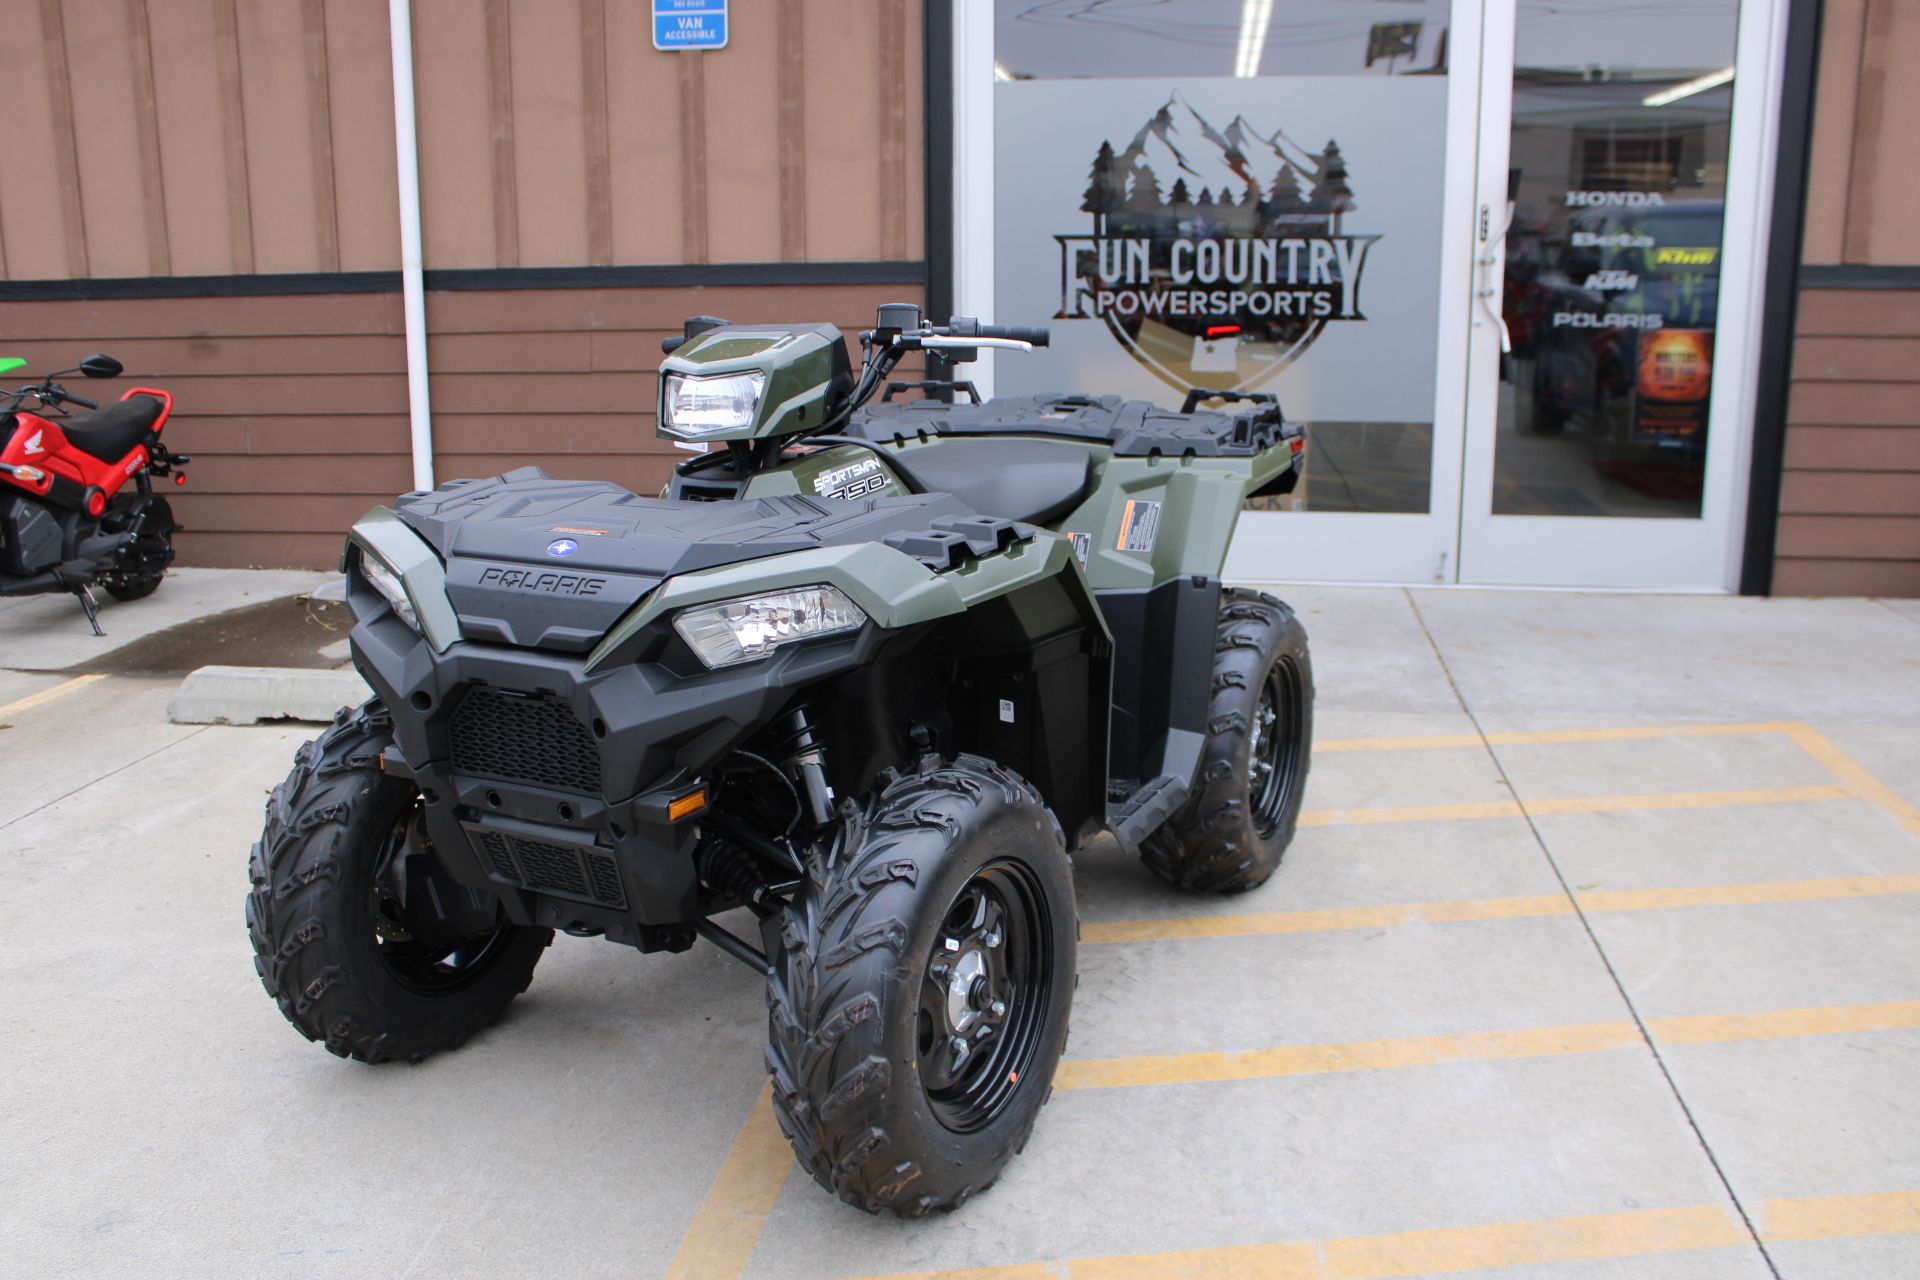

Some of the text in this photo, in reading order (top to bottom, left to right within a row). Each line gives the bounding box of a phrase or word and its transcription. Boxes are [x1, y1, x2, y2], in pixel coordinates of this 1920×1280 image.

[677, 16, 703, 30] VAN
[665, 29, 716, 40] ACCESSIBLE
[1566, 191, 1665, 207] HONDA
[1571, 232, 1655, 247] Beta
[1063, 238, 1369, 317] FUN COUNTRY
[1583, 270, 1639, 291] KTM
[1097, 290, 1332, 316] POWERSPORTS
[1552, 312, 1664, 329] POLARIS
[813, 457, 881, 493] SPORTSMAN
[478, 567, 607, 596] POLARIS
